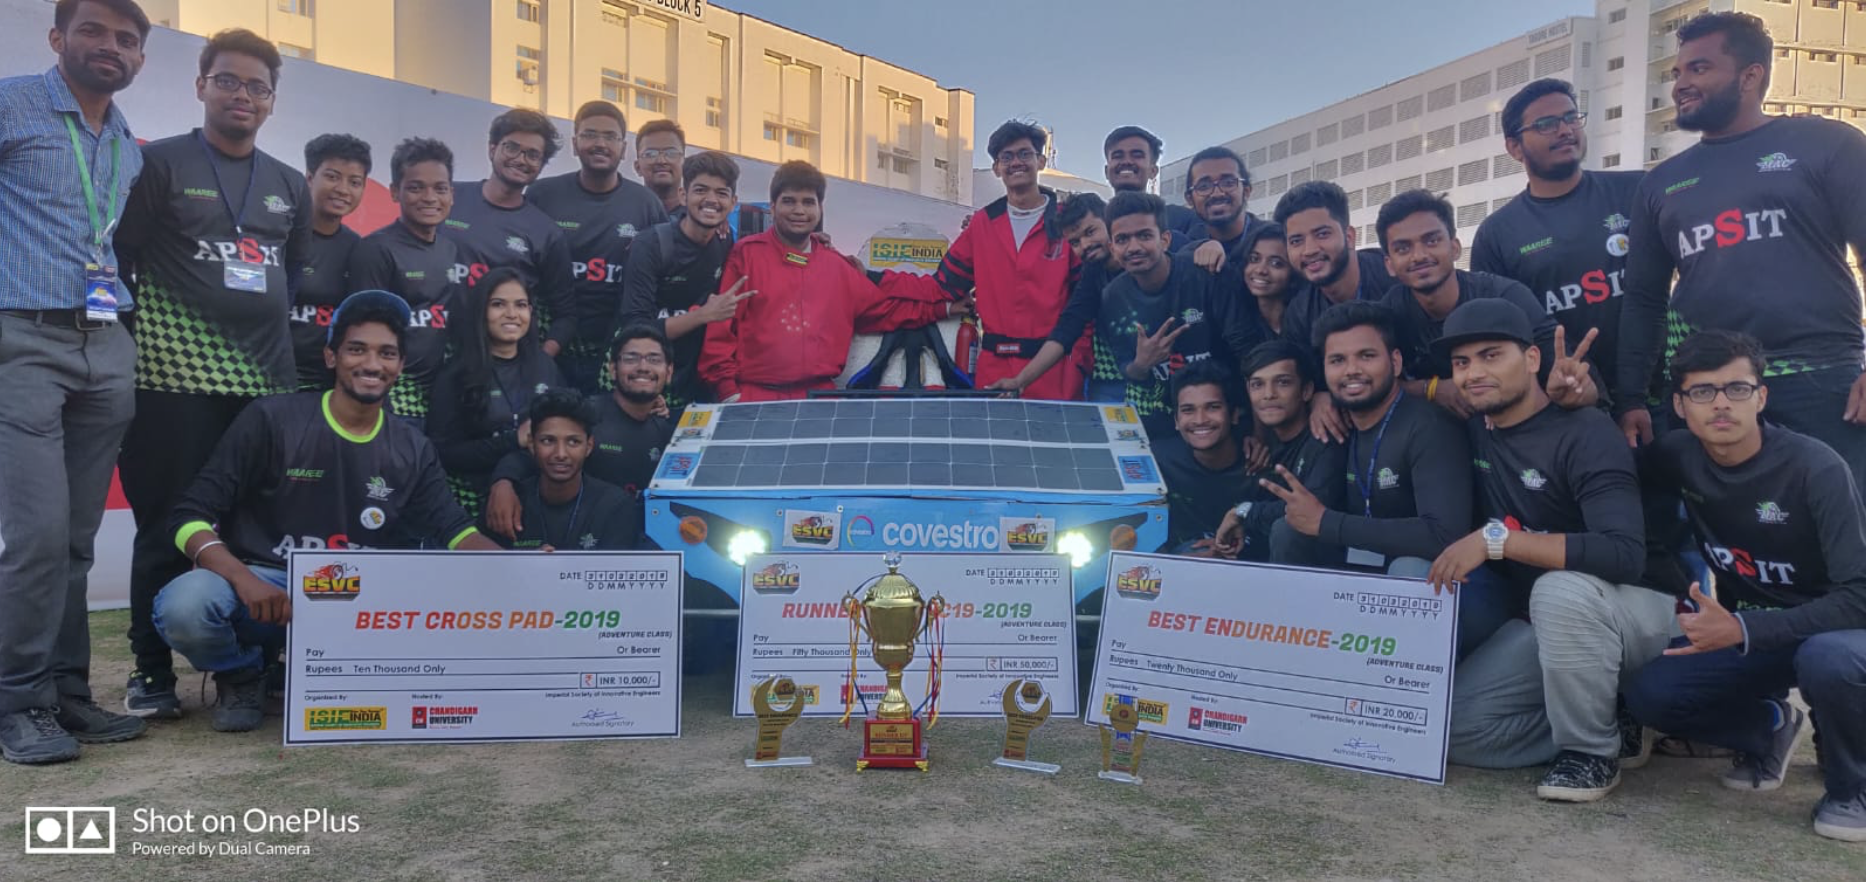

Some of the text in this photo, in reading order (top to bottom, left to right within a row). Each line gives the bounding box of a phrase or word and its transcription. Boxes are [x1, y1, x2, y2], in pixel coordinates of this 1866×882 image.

[694, 0, 701, 17] 5
[1678, 208, 1787, 260] APSIT
[912, 247, 943, 258] INDIA
[572, 257, 623, 283] PSI
[1546, 269, 1625, 315] APSI
[882, 520, 999, 550] covestro
[560, 571, 582, 581] DATE
[303, 577, 361, 592] ESVC
[1118, 577, 1161, 593] ESVC
[1334, 592, 1354, 601] DATE
[355, 610, 621, 629] BEST CROSS PAD-2019
[598, 631, 672, 639] (ADVENTURE CLASS)
[754, 634, 769, 642] Pay
[1148, 610, 1397, 656] BEST ENDURANCE-2019
[617, 646, 661, 654] Or Bearer
[1111, 639, 1126, 650] Pay
[306, 648, 324, 658] Pay
[753, 649, 783, 657] Rupees
[792, 648, 809, 657] Fifty
[811, 648, 850, 656] Thousand
[1003, 661, 1017, 669] INR
[1109, 655, 1238, 682] Rupees Twenty Thousand Only
[1366, 657, 1414, 670] (ADVENTURE
[305, 664, 446, 675] Rupees Ten Thousand Only
[600, 676, 616, 685] INR
[1384, 675, 1430, 689] Or Bearer
[429, 707, 478, 715] CHANDIGARH
[1365, 705, 1381, 715] INR
[350, 711, 382, 722] INDIA
[429, 716, 473, 724] UNIVERSITY
[1204, 710, 1248, 724] CHANDIGARH
[1203, 719, 1242, 732] UNIVERSITY
